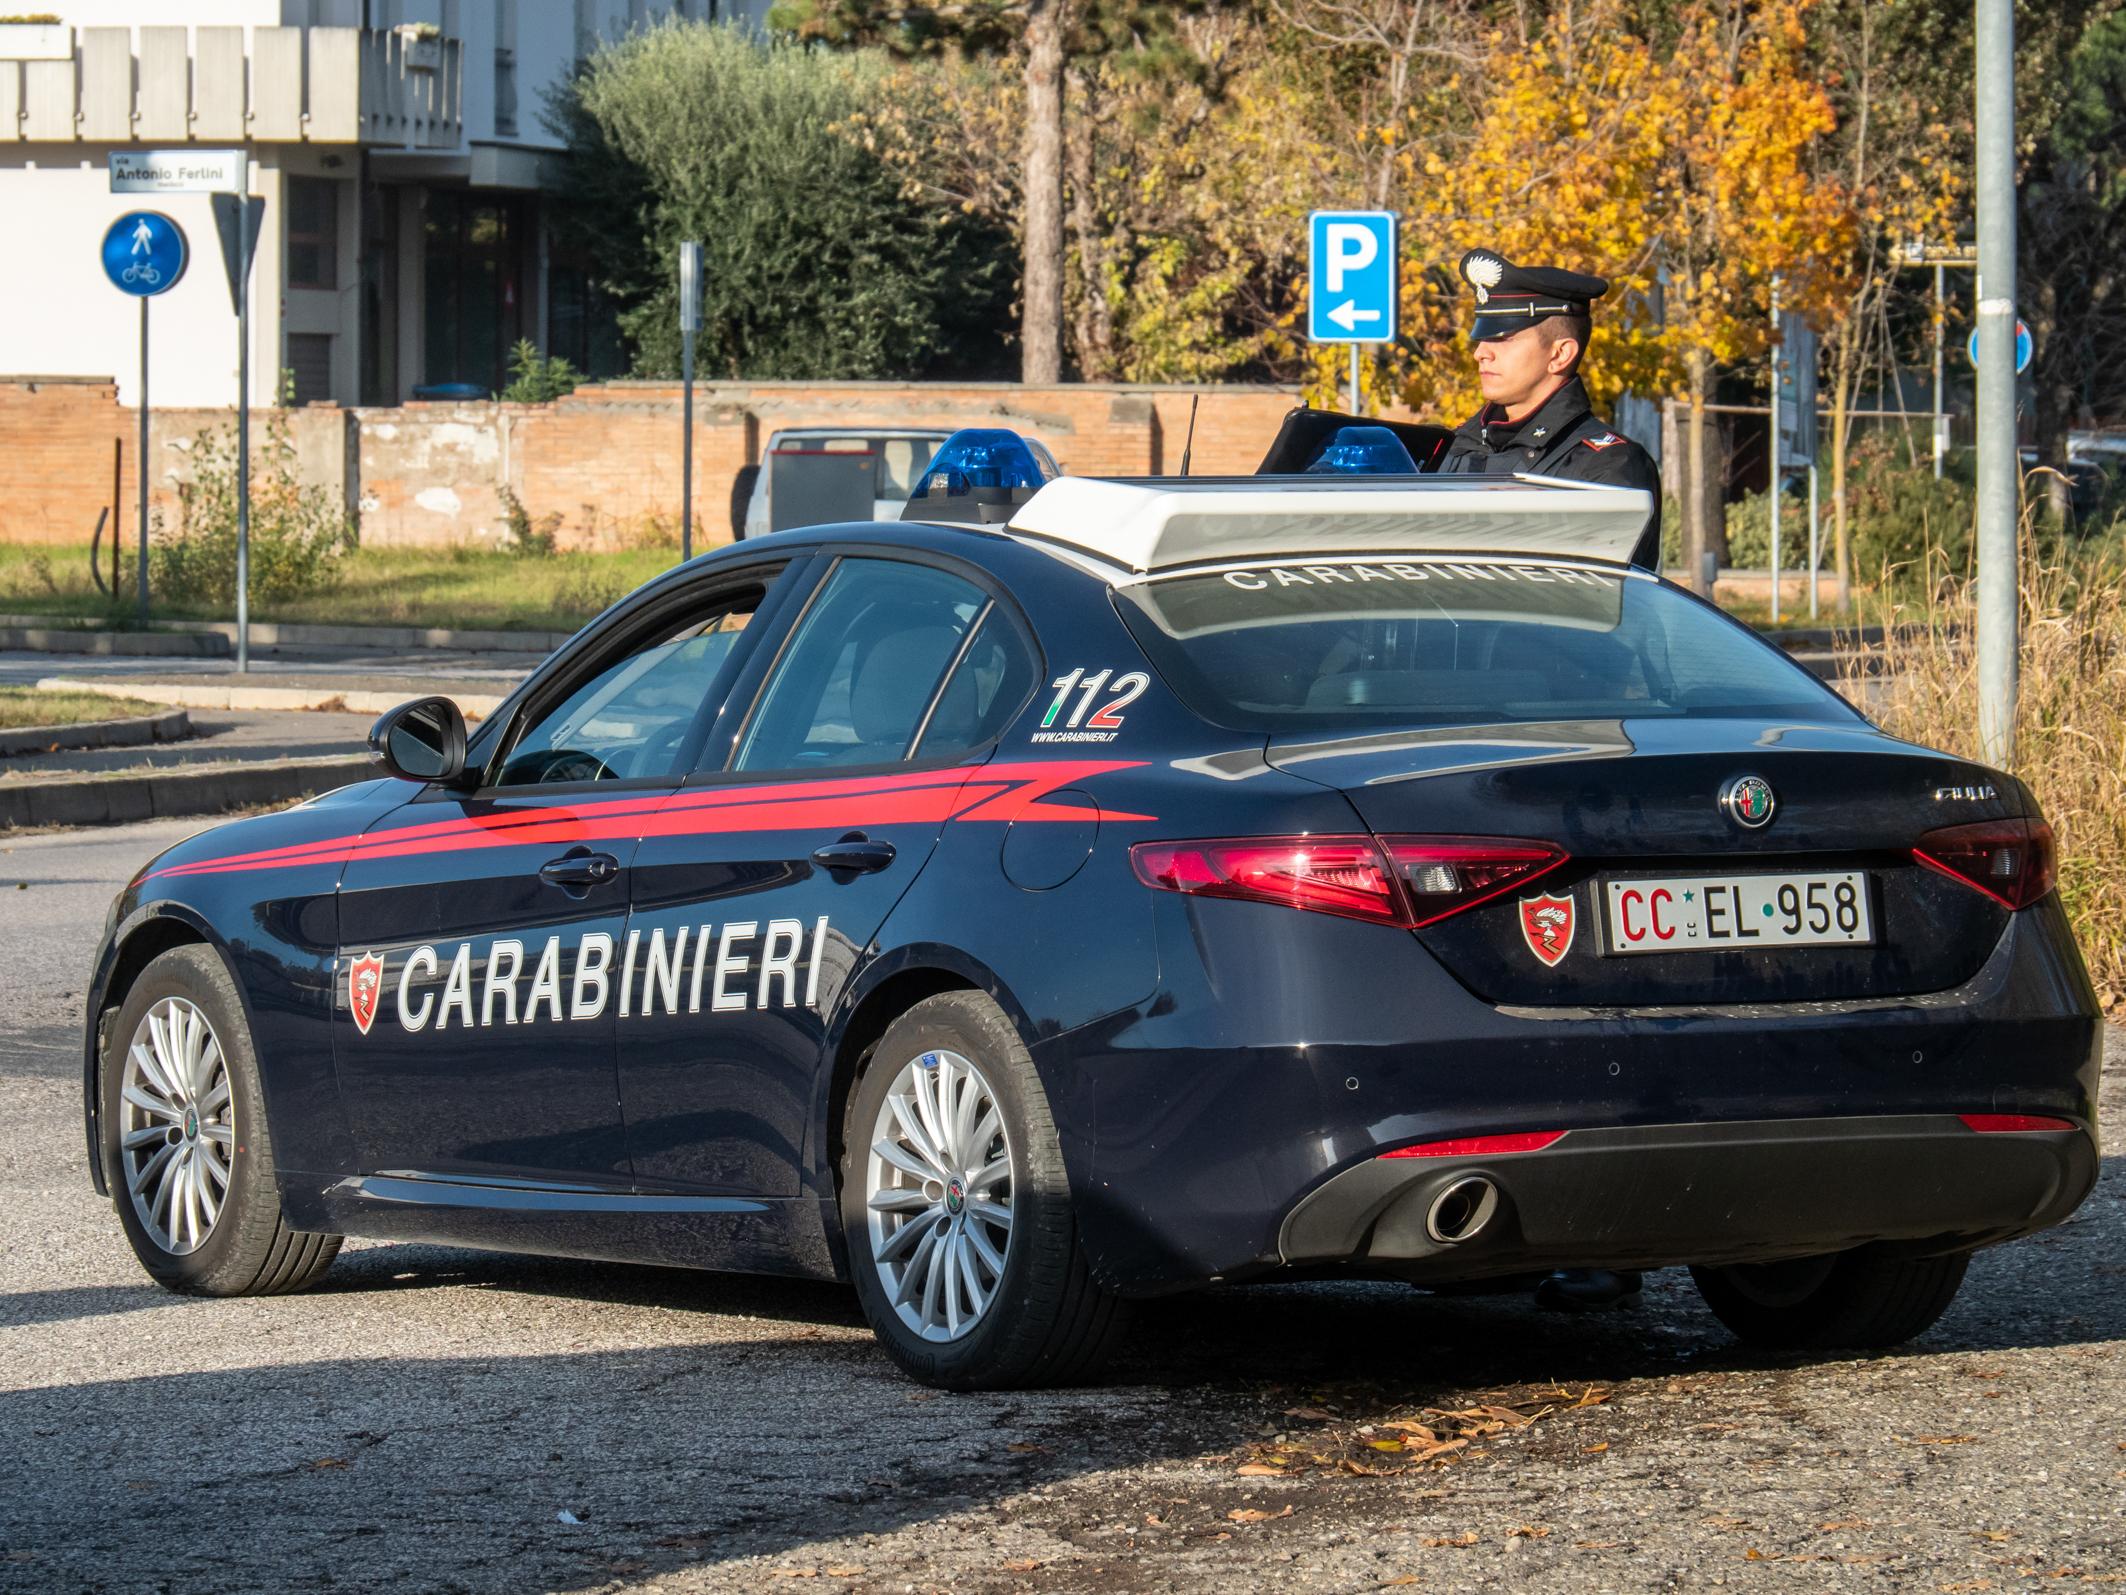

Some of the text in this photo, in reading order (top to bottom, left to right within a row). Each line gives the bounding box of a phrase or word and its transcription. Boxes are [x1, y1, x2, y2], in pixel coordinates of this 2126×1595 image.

[115, 156, 129, 165] via
[116, 168, 172, 180] Antonio
[1326, 223, 1378, 292] P
[1223, 562, 1616, 591] CARABINIERI
[1040, 668, 1150, 728] 112
[1031, 732, 1118, 743] WWW.CARABINIERI.IT
[1620, 888, 1676, 941] CC
[1703, 881, 1859, 938] EL 958
[397, 915, 829, 1032] CARABINIERI
